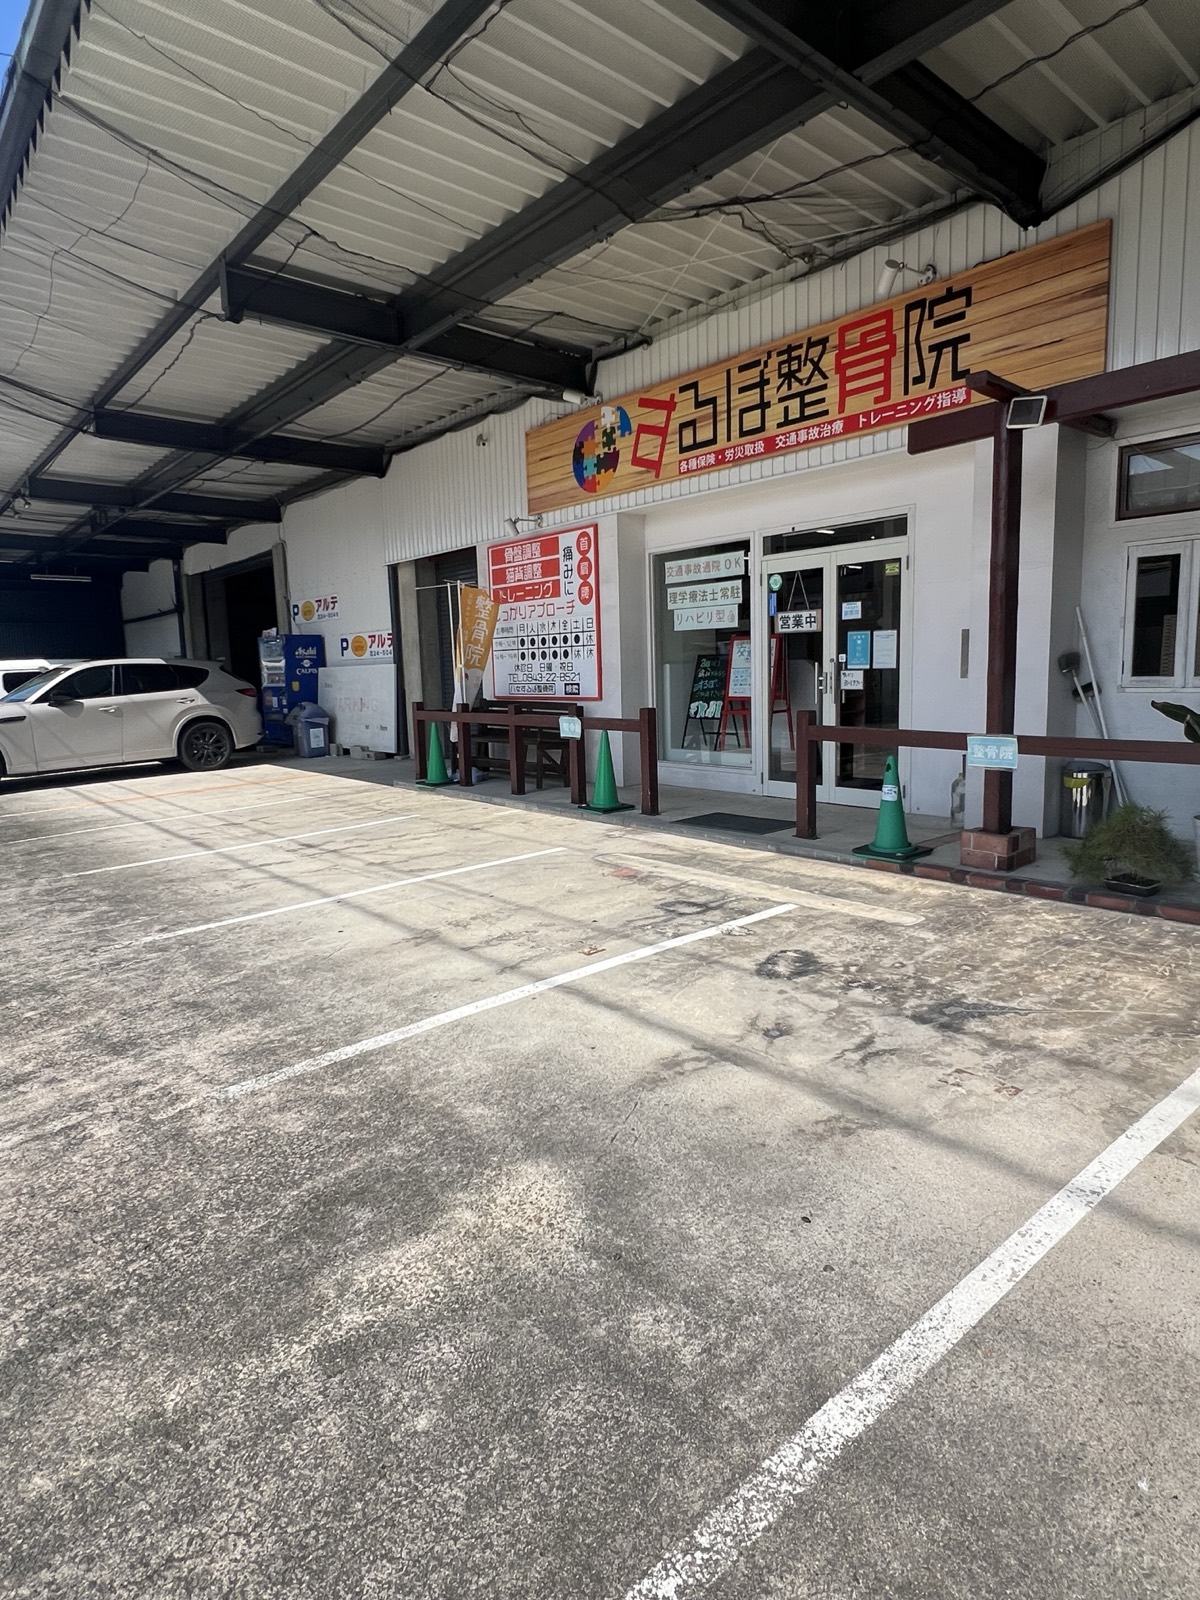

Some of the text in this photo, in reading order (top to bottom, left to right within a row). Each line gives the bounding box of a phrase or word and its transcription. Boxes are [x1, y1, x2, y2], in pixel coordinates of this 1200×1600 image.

[631, 286, 973, 478] するぼ整骨院
[679, 387, 967, 473] 各種保険・労災取扱 交通事故治療 トレーニング指導
[504, 542, 541, 564] 骨盤調整
[506, 562, 542, 584] 猫背調整
[562, 545, 574, 596] 痛みに
[666, 556, 742, 578] 交通事故通院 OK
[499, 581, 553, 602] トレーニング
[668, 585, 741, 605] 理学療法士常駐
[292, 604, 300, 621] P
[315, 596, 338, 612] アルテ
[498, 600, 575, 621] っかりアプローチ
[465, 594, 494, 667] 整骨院
[519, 623, 525, 635] 月
[539, 622, 546, 633] 水
[550, 621, 557, 631] 木
[561, 619, 568, 631] 金
[573, 620, 580, 629] 土
[586, 618, 593, 629] 日
[779, 613, 817, 630] 営業中
[340, 638, 349, 657] P
[368, 633, 393, 649] アルテ
[585, 633, 594, 644] 休
[295, 646, 316, 656] Asahi
[574, 649, 582, 658] 休
[586, 647, 594, 659] 休
[296, 668, 318, 676] CALPIS
[972, 744, 1013, 760] 整骨院
